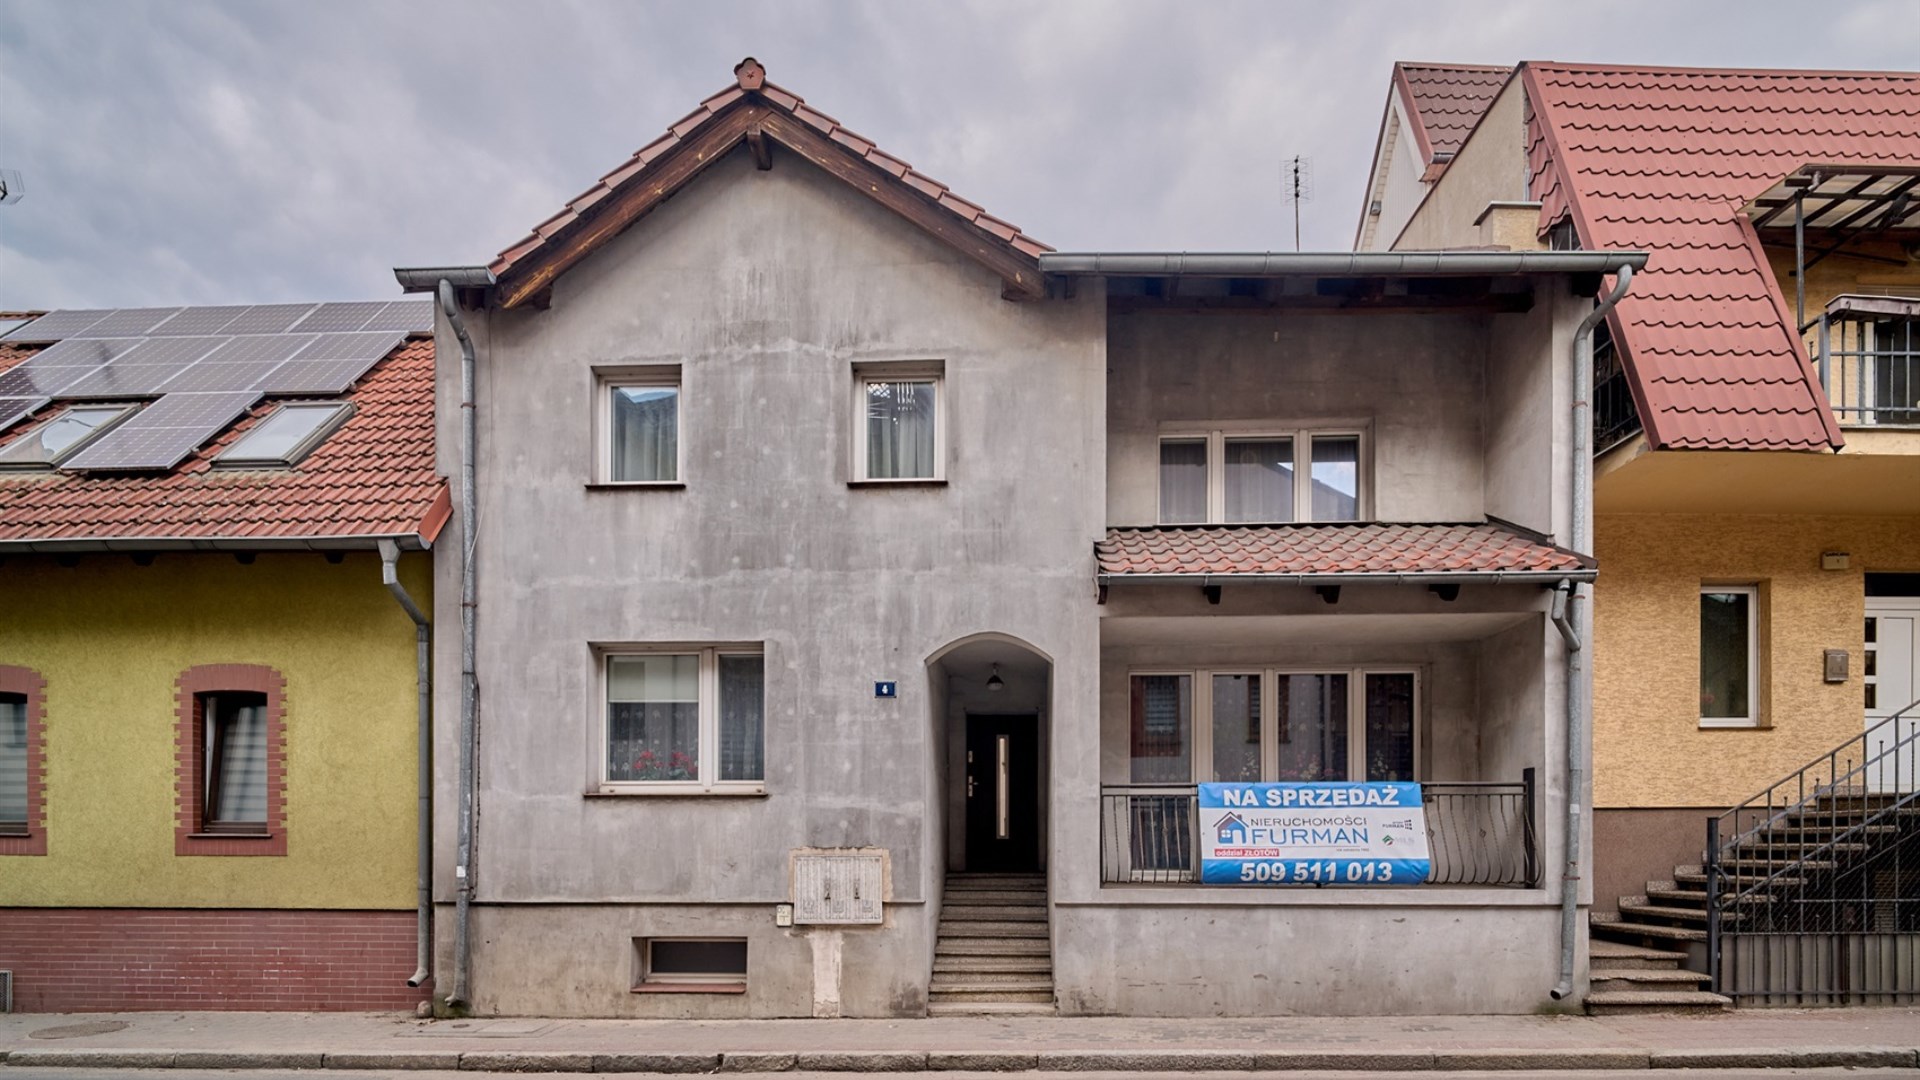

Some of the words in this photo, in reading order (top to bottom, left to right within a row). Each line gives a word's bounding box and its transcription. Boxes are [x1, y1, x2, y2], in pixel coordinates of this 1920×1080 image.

[1223, 789, 1258, 806] NA
[1266, 785, 1400, 806] SPRZEDAŻ
[1250, 815, 1367, 827] NIERUCHOMOŚCI
[1252, 828, 1369, 845] FURMAN
[1240, 862, 1286, 882] 509
[1293, 862, 1337, 882] 511
[1347, 862, 1392, 882] 013
